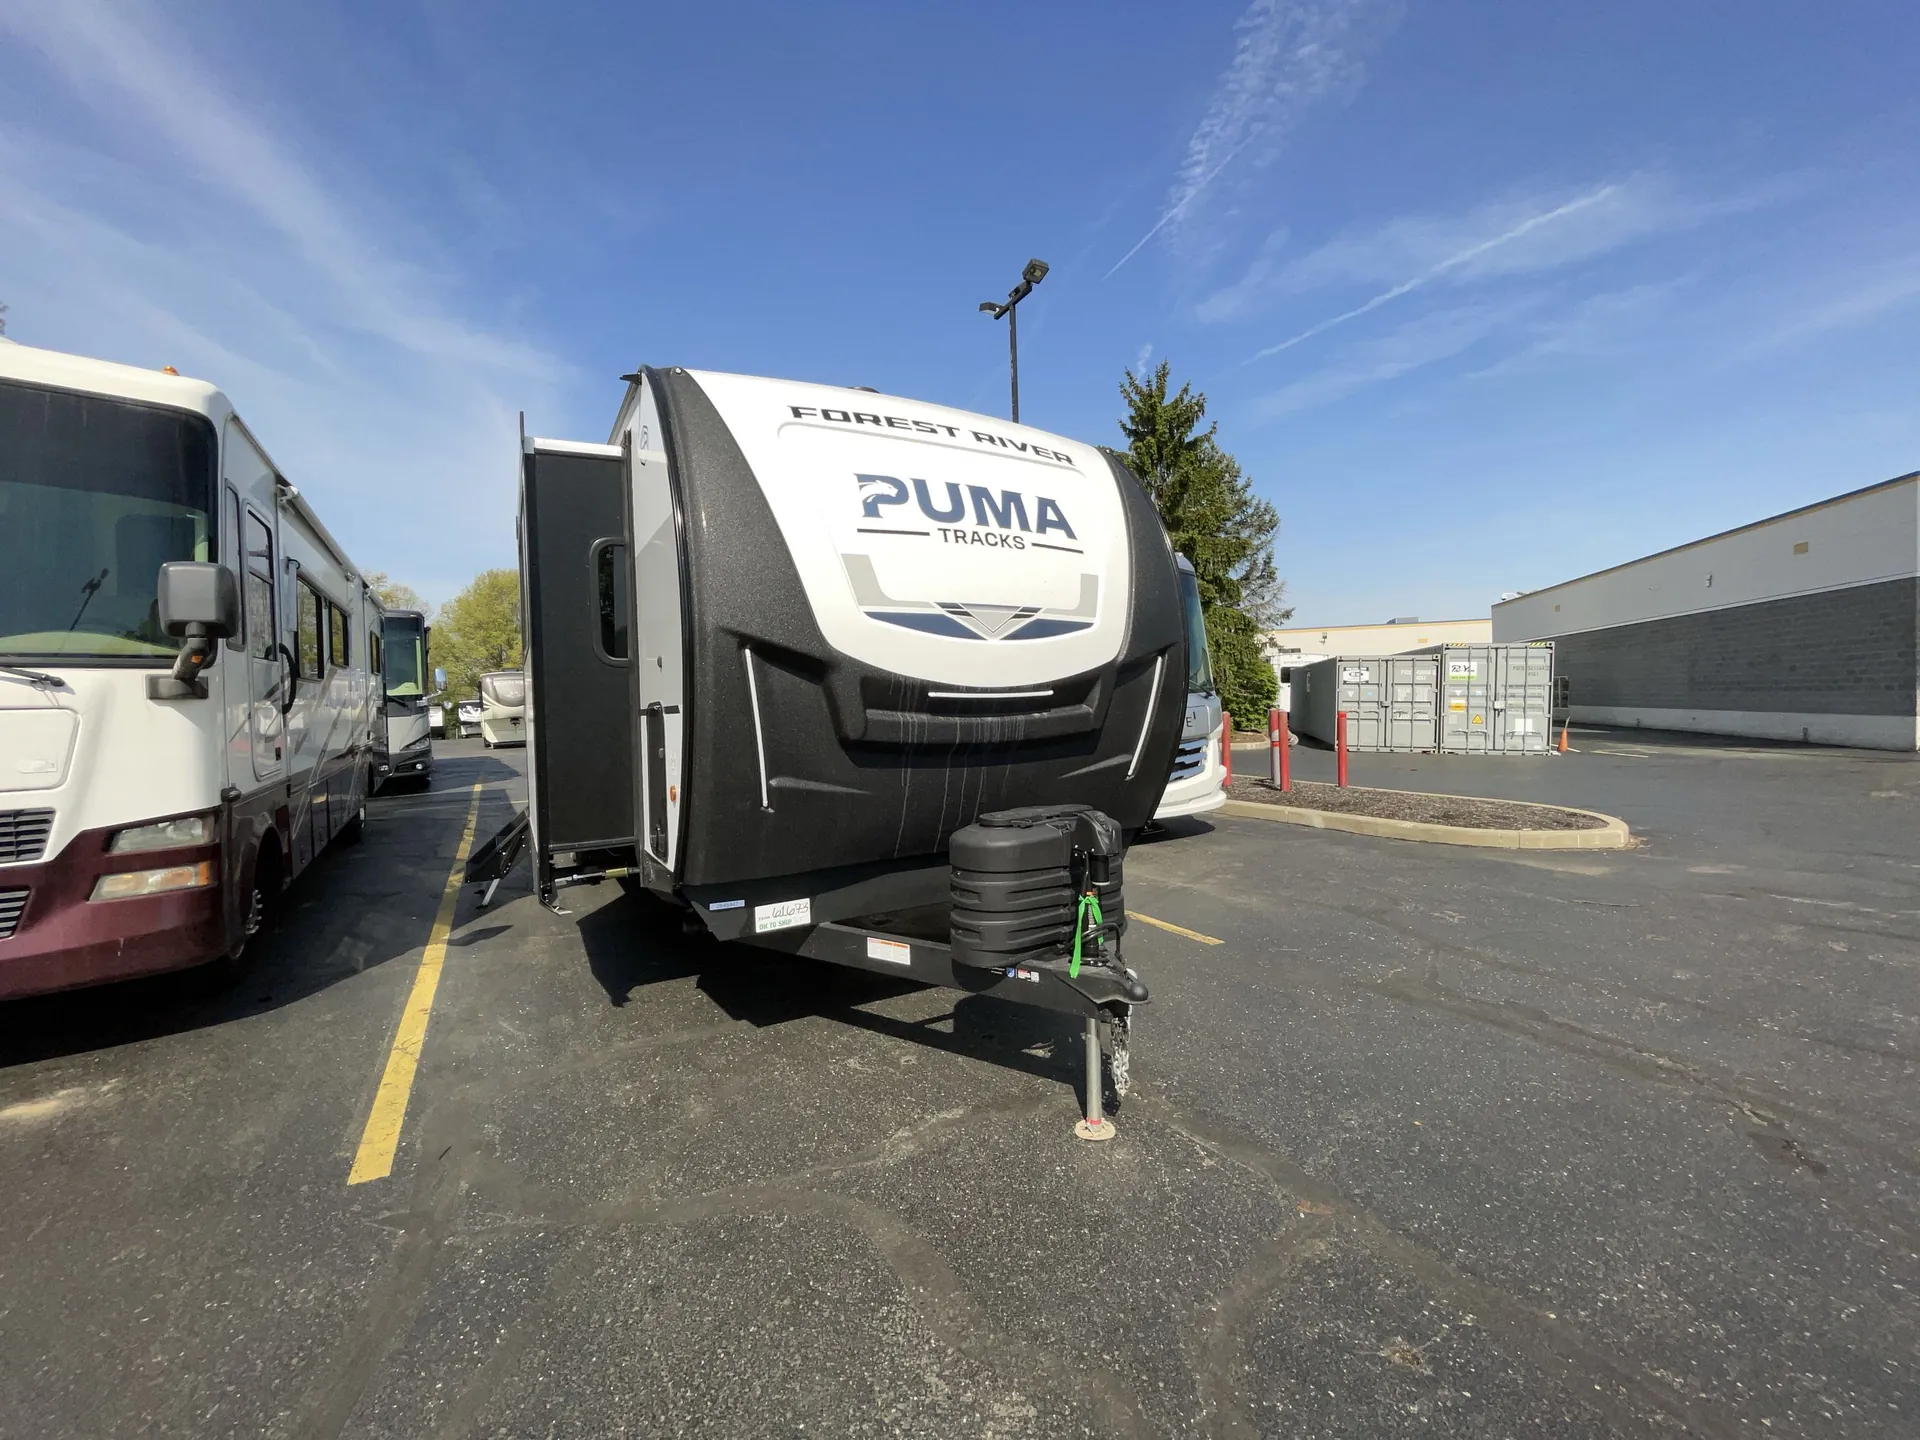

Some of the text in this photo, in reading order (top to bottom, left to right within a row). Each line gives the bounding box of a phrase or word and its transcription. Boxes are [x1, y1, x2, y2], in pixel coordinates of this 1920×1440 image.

[787, 405, 1077, 467] FOREST RIVER
[853, 473, 1078, 541] PUMA
[937, 528, 1026, 550] TRACKS
